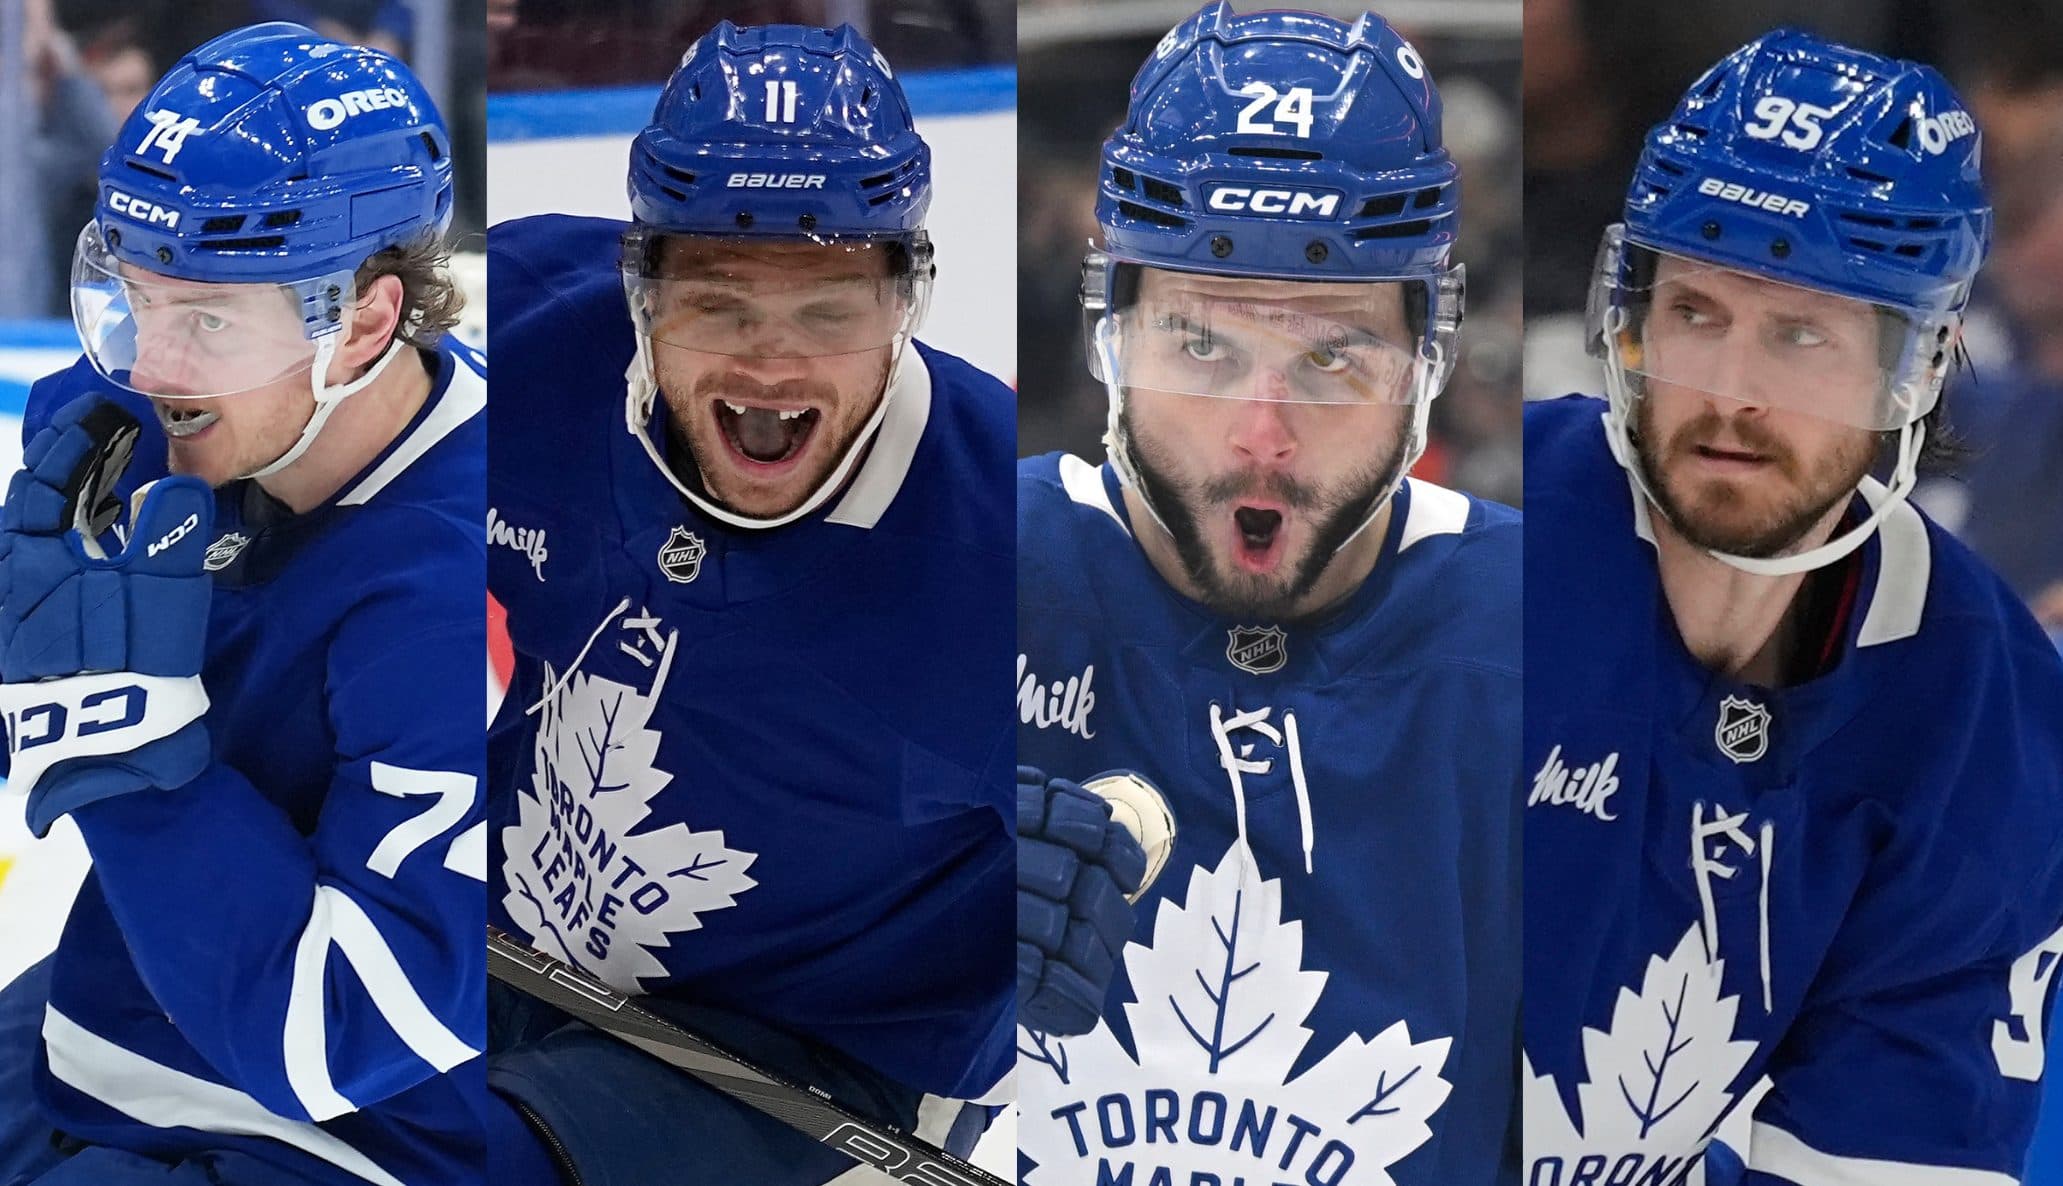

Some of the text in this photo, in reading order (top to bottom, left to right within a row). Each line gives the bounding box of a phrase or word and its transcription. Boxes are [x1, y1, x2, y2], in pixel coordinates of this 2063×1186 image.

[306, 87, 407, 131] OREO
[765, 81, 797, 122] 11
[1237, 81, 1314, 138] 24
[1744, 96, 1832, 152] 95
[135, 108, 201, 165] 74
[726, 173, 826, 190] BAUER
[1209, 188, 1340, 216] CCM
[1698, 178, 1811, 219] BAUER
[109, 191, 181, 229] CCM
[147, 513, 198, 557] CCM
[487, 508, 548, 583] Milk
[666, 549, 696, 564] NHL
[1241, 640, 1275, 662] NHL
[8, 684, 148, 754] CC
[1017, 653, 1096, 740] Milk
[1726, 720, 1759, 745] NHL
[1528, 744, 1620, 821] Milk
[541, 747, 670, 916] TORONTO
[550, 798, 625, 931] MAPLE
[531, 831, 612, 961] LEAFS
[1050, 1088, 1355, 1186] TORONTO
